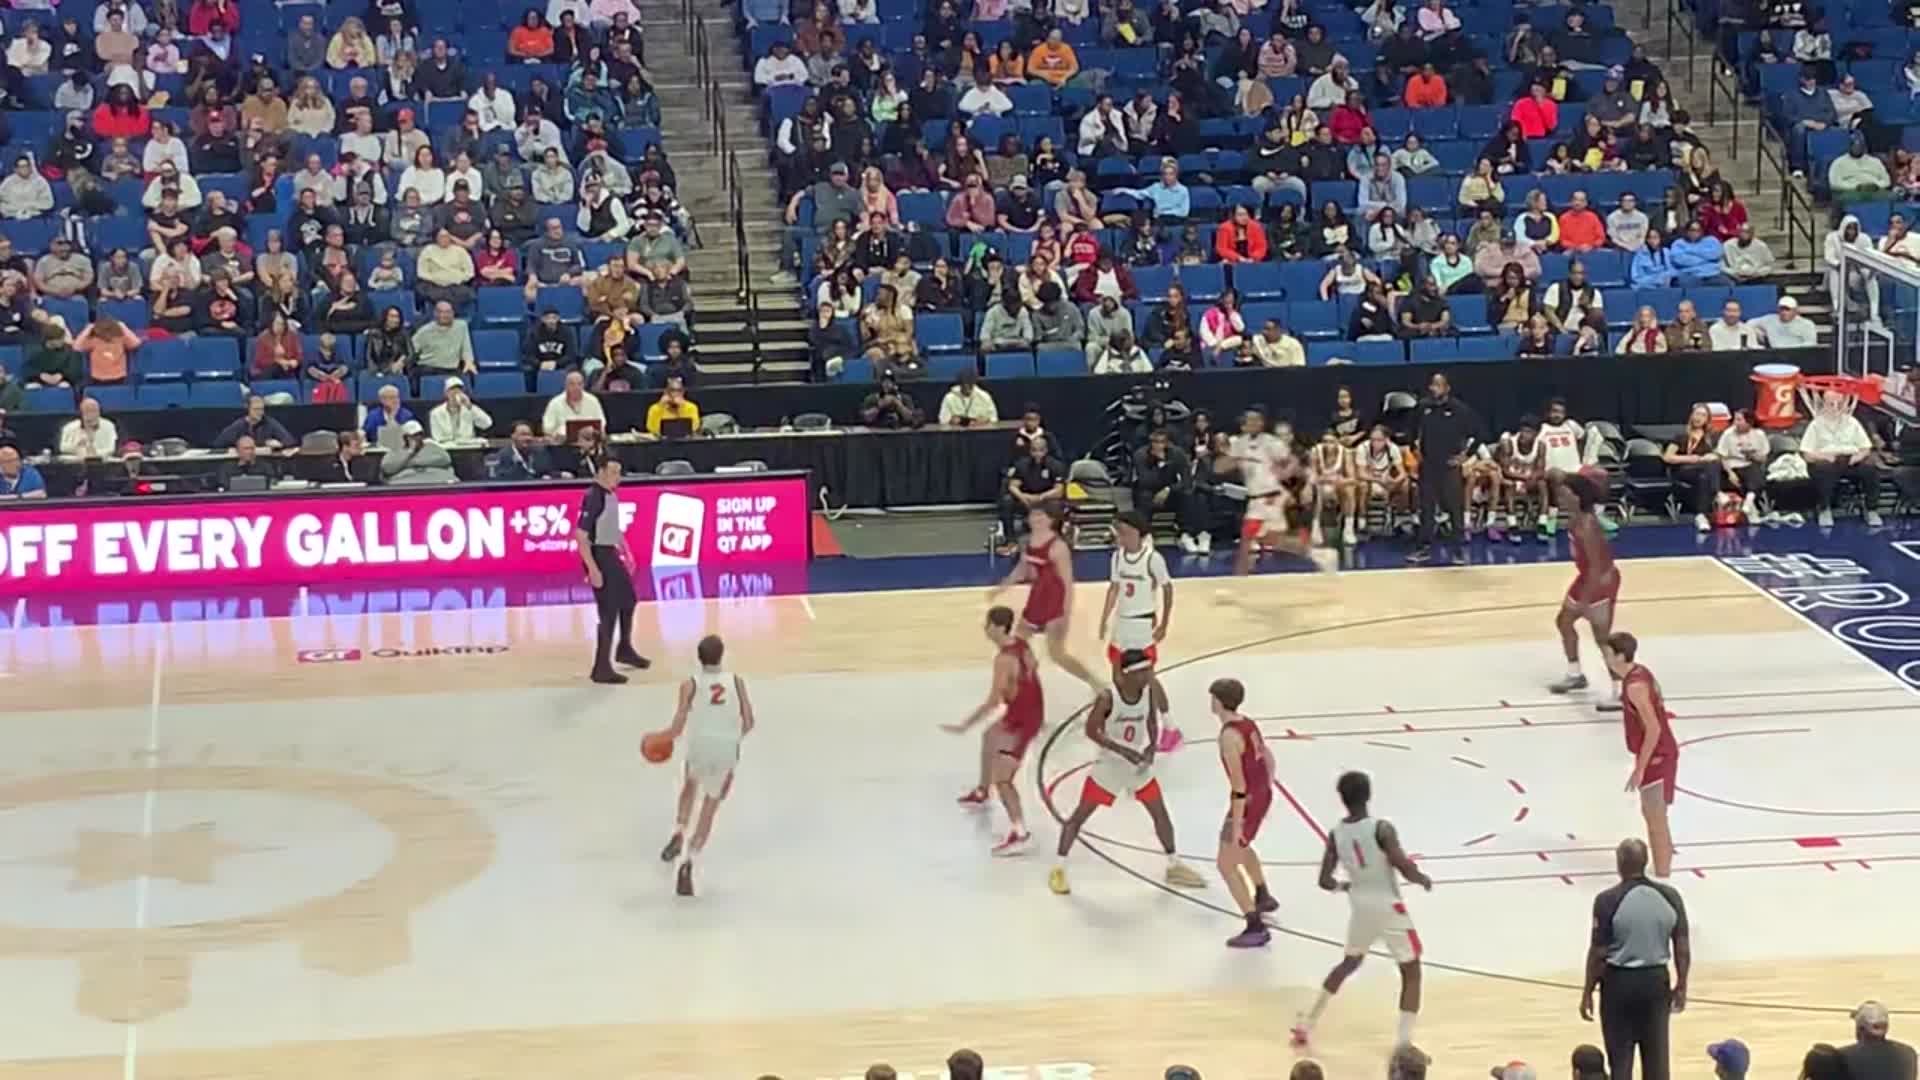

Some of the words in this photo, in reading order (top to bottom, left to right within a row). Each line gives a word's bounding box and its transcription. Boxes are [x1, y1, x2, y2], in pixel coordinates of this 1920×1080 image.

[717, 497, 753, 514] SIGN
[755, 496, 777, 512] UP
[510, 503, 571, 536] +5%
[717, 517, 733, 533] IN
[736, 515, 766, 532] THE
[0, 523, 78, 577] FF
[93, 515, 273, 576] EVERY
[285, 506, 505, 568] GALLON
[662, 526, 690, 553] QT
[717, 536, 738, 553] QT
[741, 534, 772, 551] APP
[1125, 582, 1136, 598] 3
[709, 683, 726, 705] 2
[1123, 725, 1136, 742] 0
[1353, 839, 1366, 867] 1
